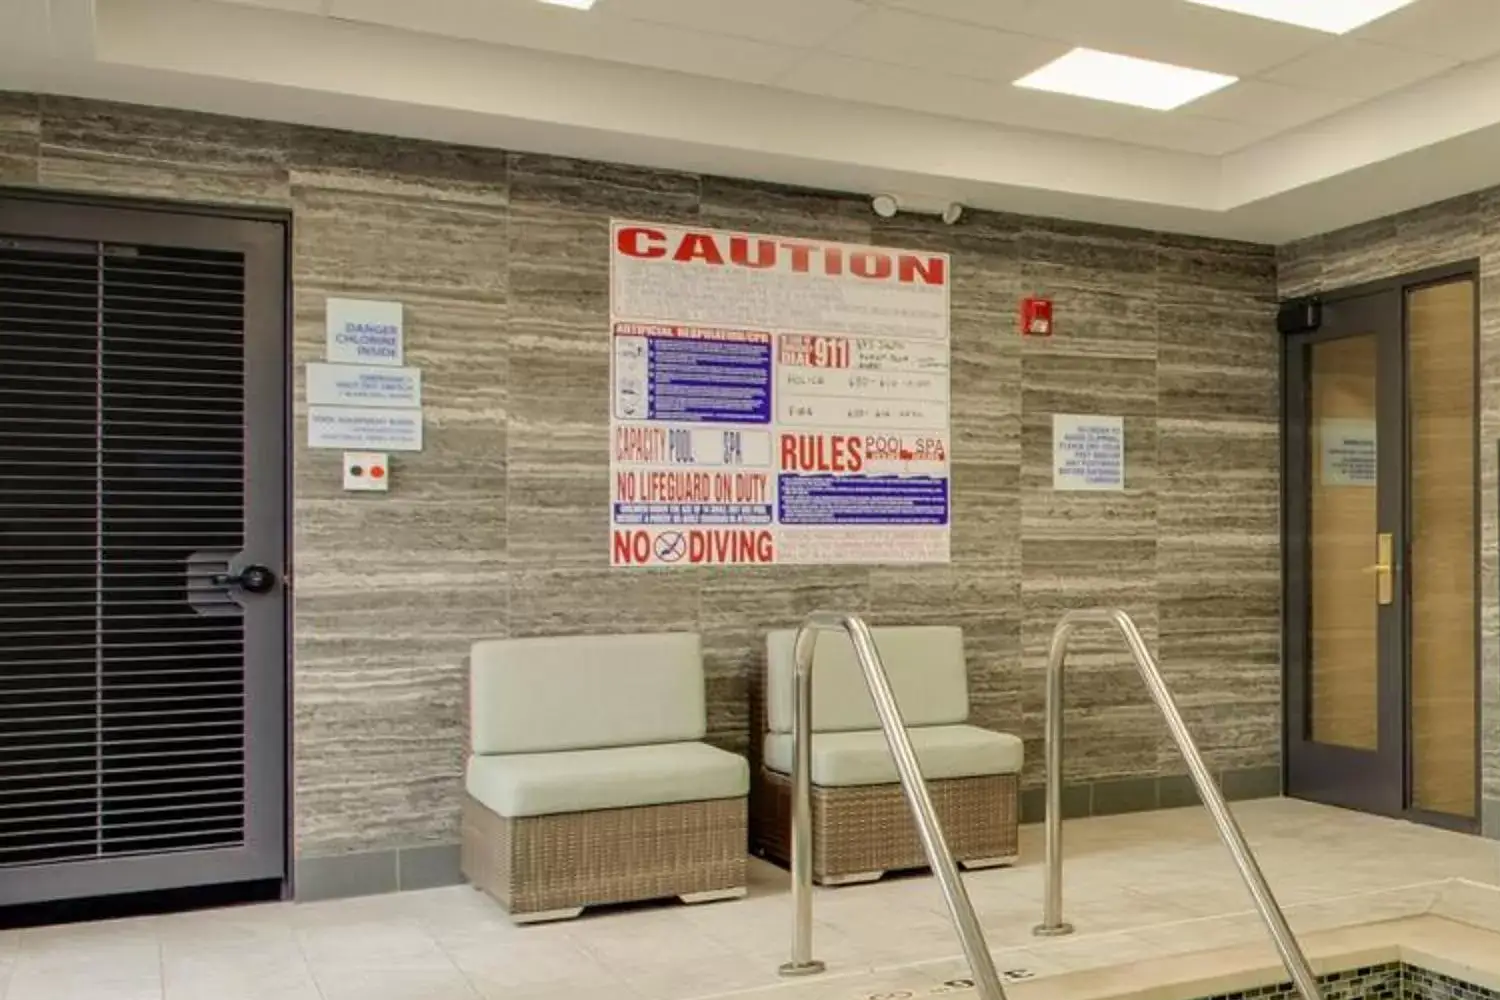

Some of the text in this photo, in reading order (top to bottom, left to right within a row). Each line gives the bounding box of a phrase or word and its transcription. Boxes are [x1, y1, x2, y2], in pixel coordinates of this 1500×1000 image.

[616, 227, 945, 286] CAUTION
[814, 337, 848, 369] 911
[616, 427, 742, 464] CAPACITY POOL SPA
[781, 434, 863, 473] RULES
[865, 436, 905, 453] POOL
[617, 472, 635, 501] NO
[640, 472, 710, 501] LIFEGUARD
[715, 474, 732, 501] ON
[737, 474, 768, 502] DUTY
[614, 530, 650, 563] NO
[688, 530, 773, 563] DIVING
